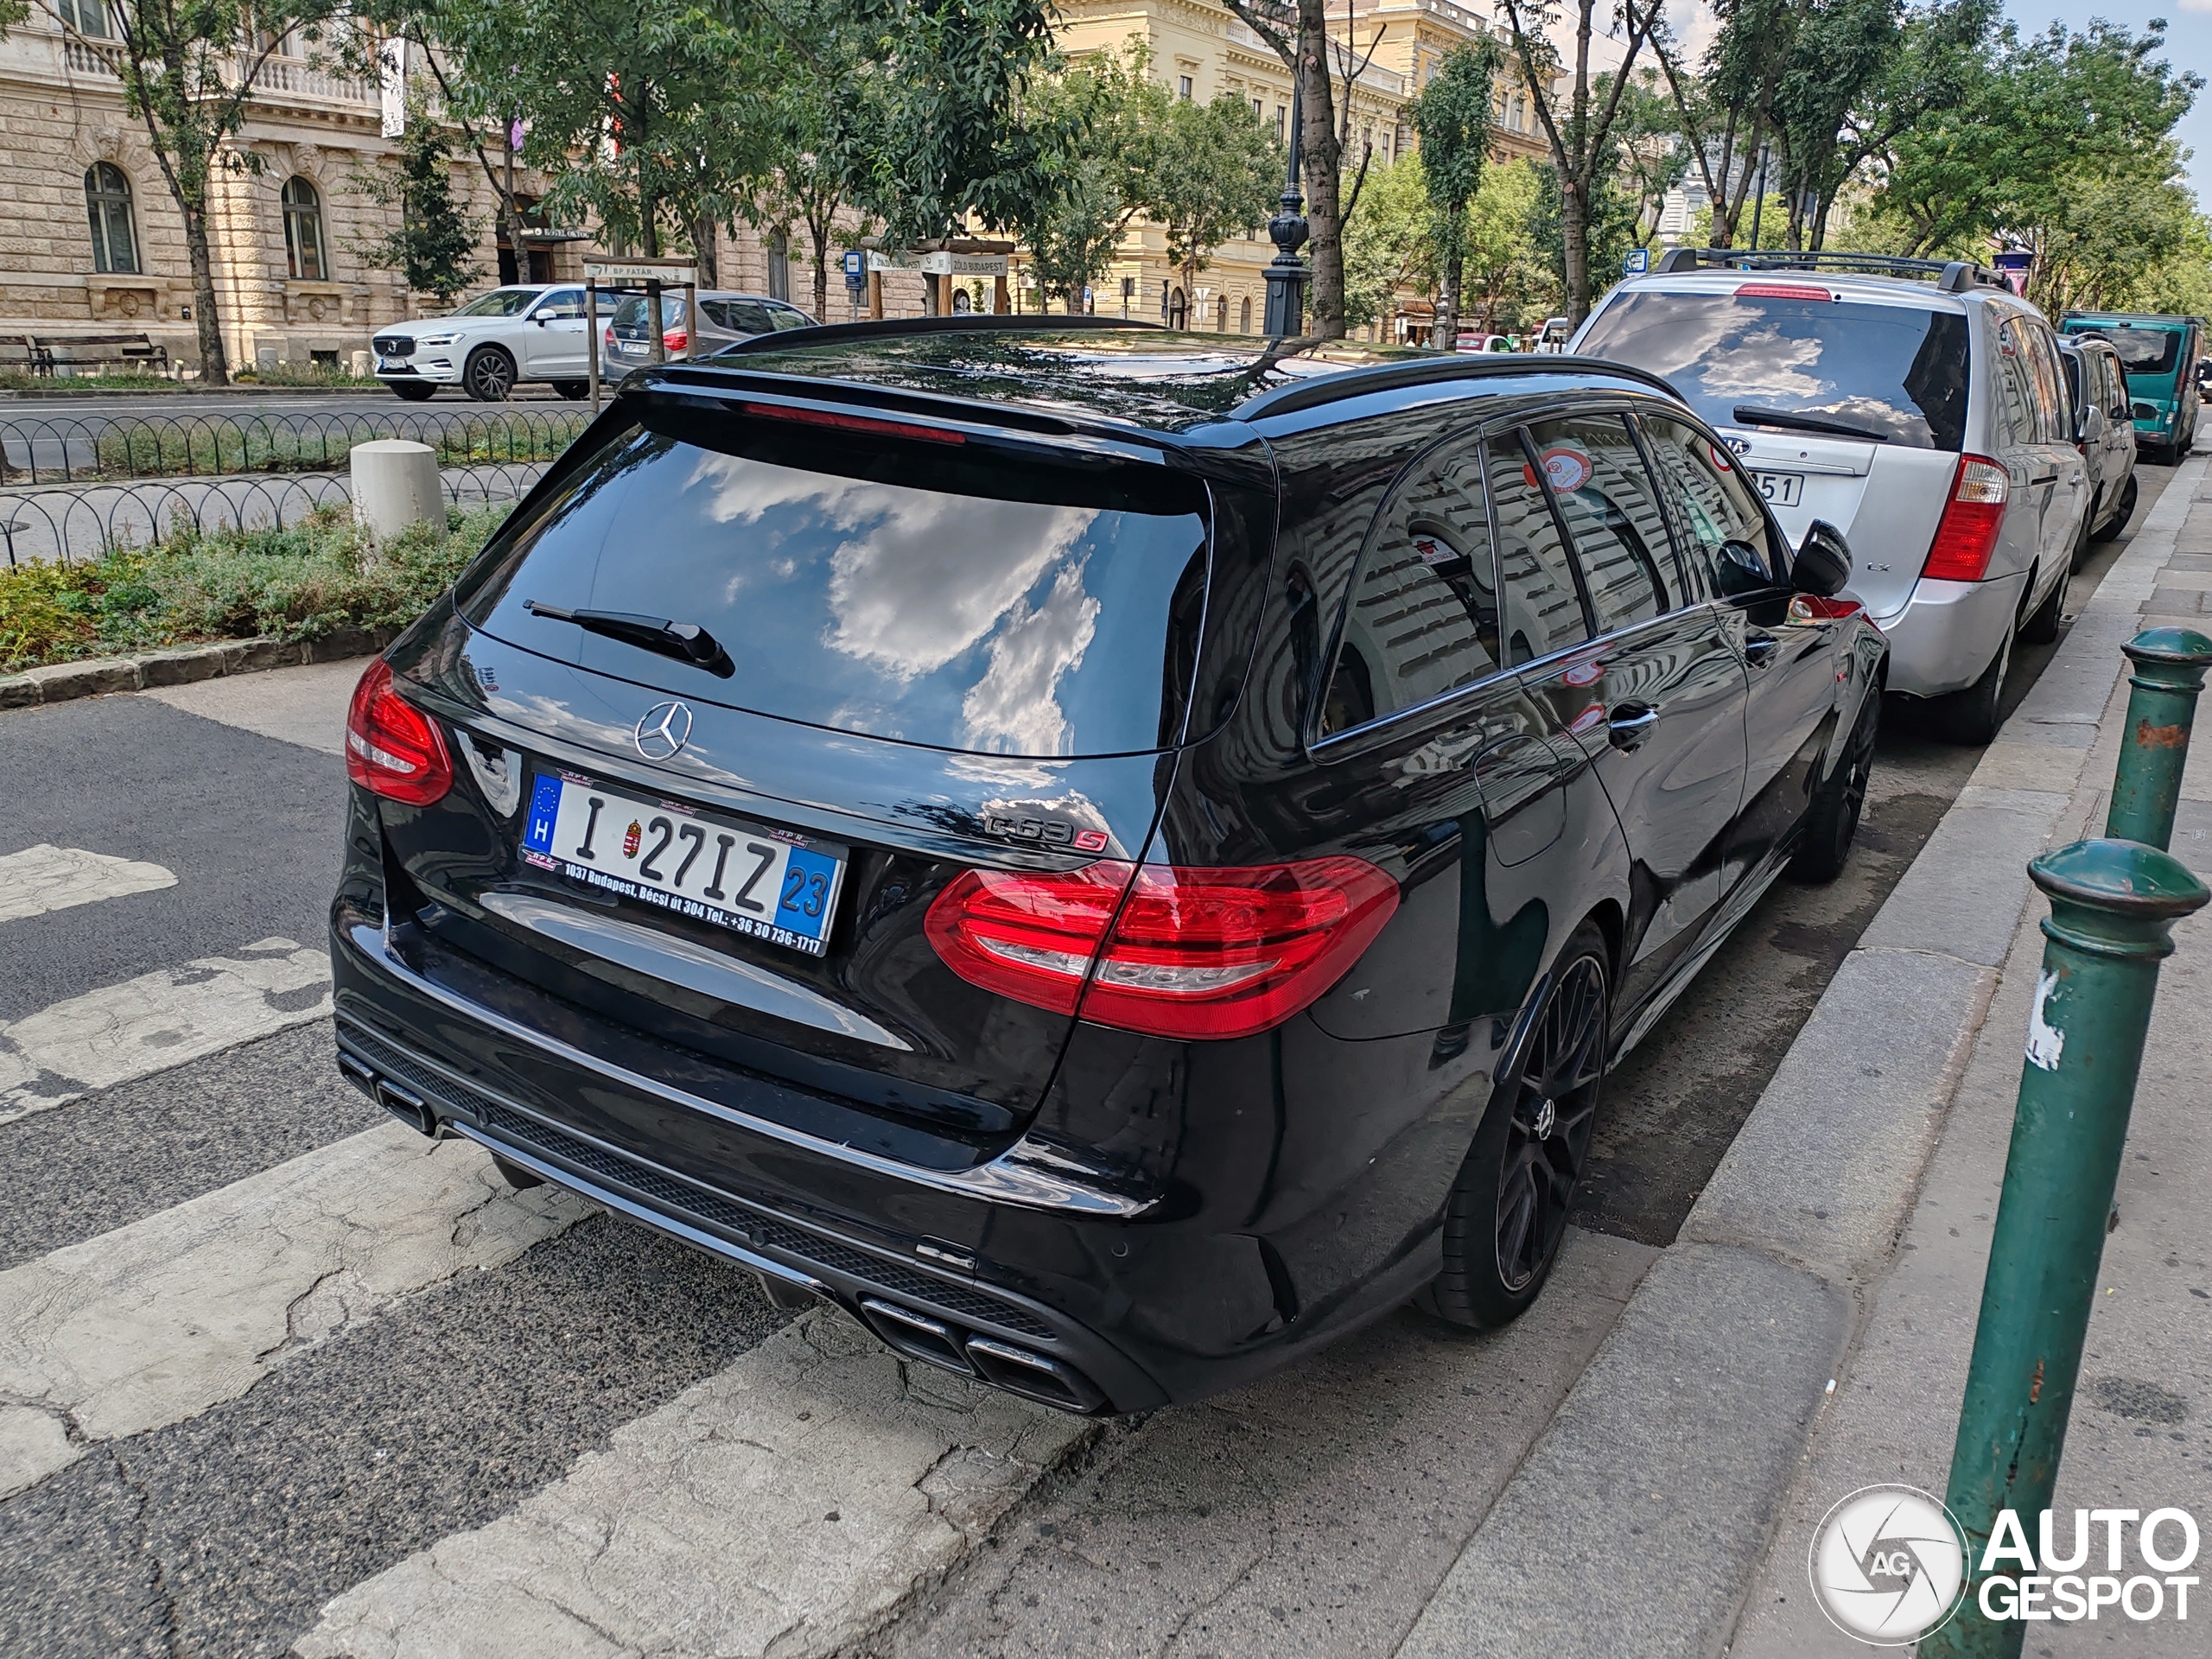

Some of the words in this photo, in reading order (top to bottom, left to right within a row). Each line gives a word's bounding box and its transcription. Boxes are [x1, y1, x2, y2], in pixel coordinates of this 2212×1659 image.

[954, 260, 968, 270] ZÖLD
[969, 261, 1003, 271] BUDAPEST
[534, 818, 549, 842] H
[565, 863, 588, 880] 1037
[588, 870, 638, 898] Budapest,
[639, 886, 670, 906] Bécsi
[670, 896, 683, 911] út
[683, 899, 704, 918] 304
[706, 907, 728, 926] Tel.:
[730, 917, 753, 933] +36
[754, 922, 770, 938] 30
[772, 927, 821, 954] 736-1717
[781, 867, 828, 916] 23
